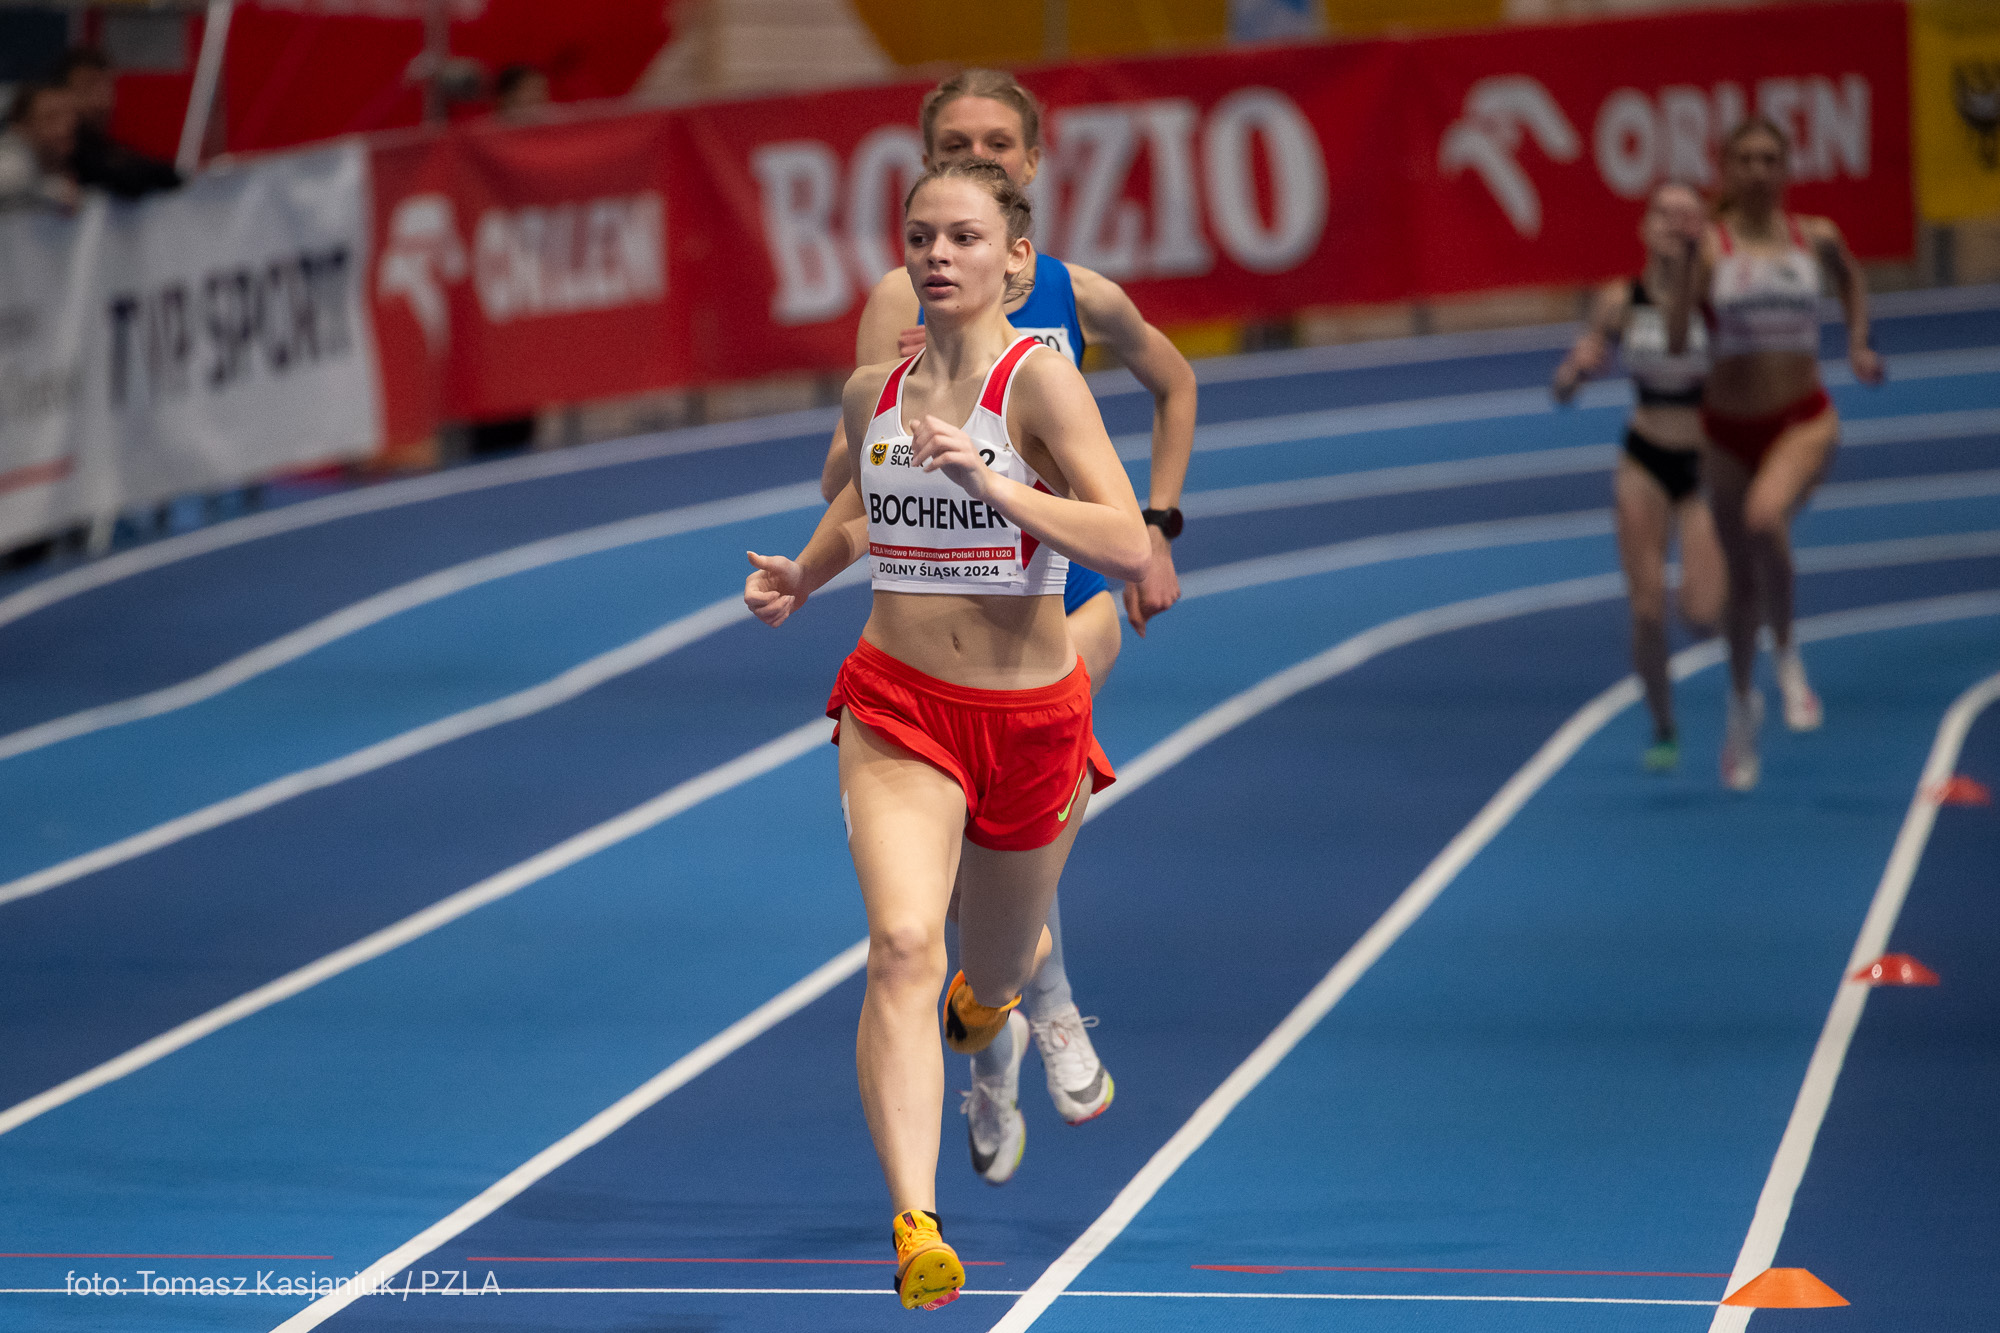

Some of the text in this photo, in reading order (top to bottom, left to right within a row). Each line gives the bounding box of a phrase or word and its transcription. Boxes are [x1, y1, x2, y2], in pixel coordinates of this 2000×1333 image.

[751, 86, 1330, 325] BOZIO
[892, 444, 914, 455] DOL
[908, 549, 950, 559] Mistrzostwa
[951, 551, 975, 559] Polski
[976, 550, 990, 558] U18
[995, 549, 1012, 558] U20
[879, 562, 1000, 579] DOLNY ŚLĄSK 2024
